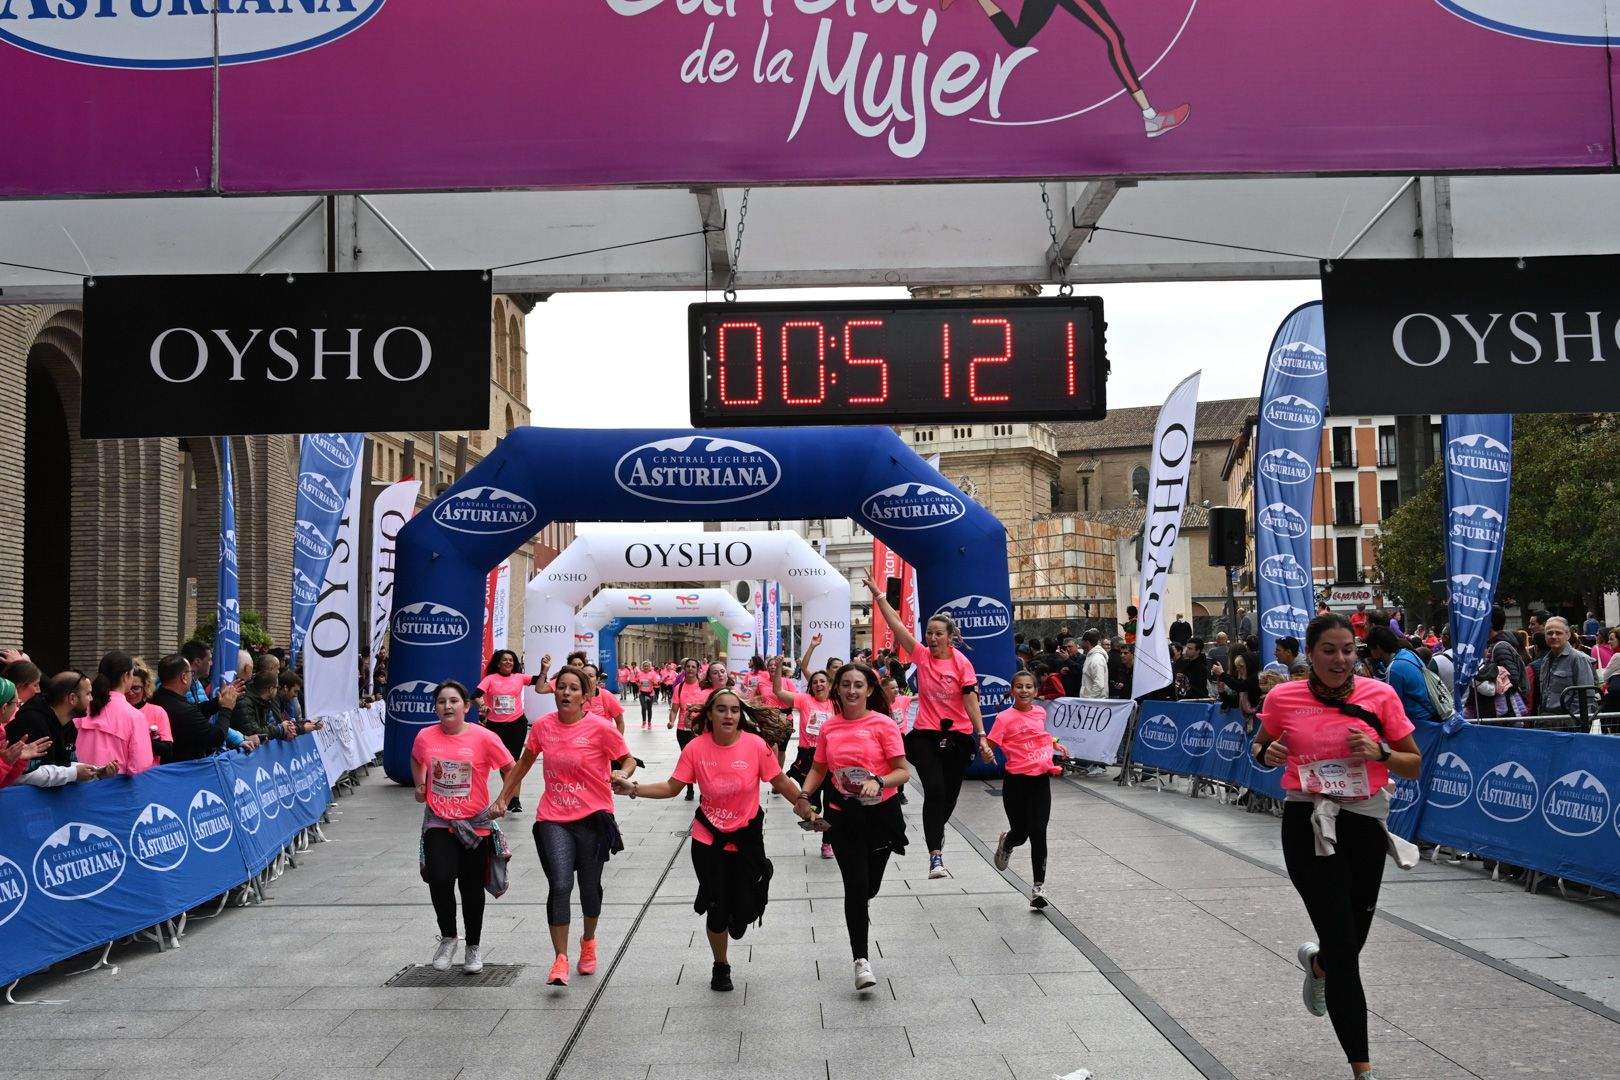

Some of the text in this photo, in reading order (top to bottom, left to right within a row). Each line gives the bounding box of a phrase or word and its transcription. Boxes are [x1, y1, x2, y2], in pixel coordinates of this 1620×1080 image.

[680, 8, 1039, 158] de la Mujer
[1392, 311, 1620, 366] OYSH
[150, 327, 432, 383] OYSHO
[1277, 353, 1325, 371] ASTURIANA
[1267, 406, 1316, 425] ASTURIANA
[653, 456, 763, 464] CENTRAL LECHERA
[1263, 458, 1306, 478] ASTURIANA
[628, 457, 769, 486] ASTURIANA
[300, 478, 338, 510] ASTURIANA
[438, 503, 528, 522] ASTURIANA
[870, 502, 960, 519] ASTURIANA
[1142, 422, 1188, 637] OYSHO
[624, 541, 753, 569] OYSHO
[548, 572, 587, 583] OYSHO
[788, 567, 827, 578] OYSHO
[394, 617, 463, 636] ASTURIANA
[529, 624, 566, 634] OYSHO
[808, 620, 845, 630] OYSHO
[950, 614, 1008, 629] TURIANA
[388, 695, 436, 714] ASTURIA
[1053, 704, 1112, 732] OYSHO
[1432, 777, 1467, 797] TURIANA
[1480, 780, 1532, 810] ASTURIANA
[1545, 790, 1603, 823] ASTURIANA
[192, 814, 231, 841] ASTURIANA
[138, 829, 187, 860] ASTURIANA
[52, 848, 82, 862] CENTRAL
[43, 850, 121, 889] ASTURIANA
